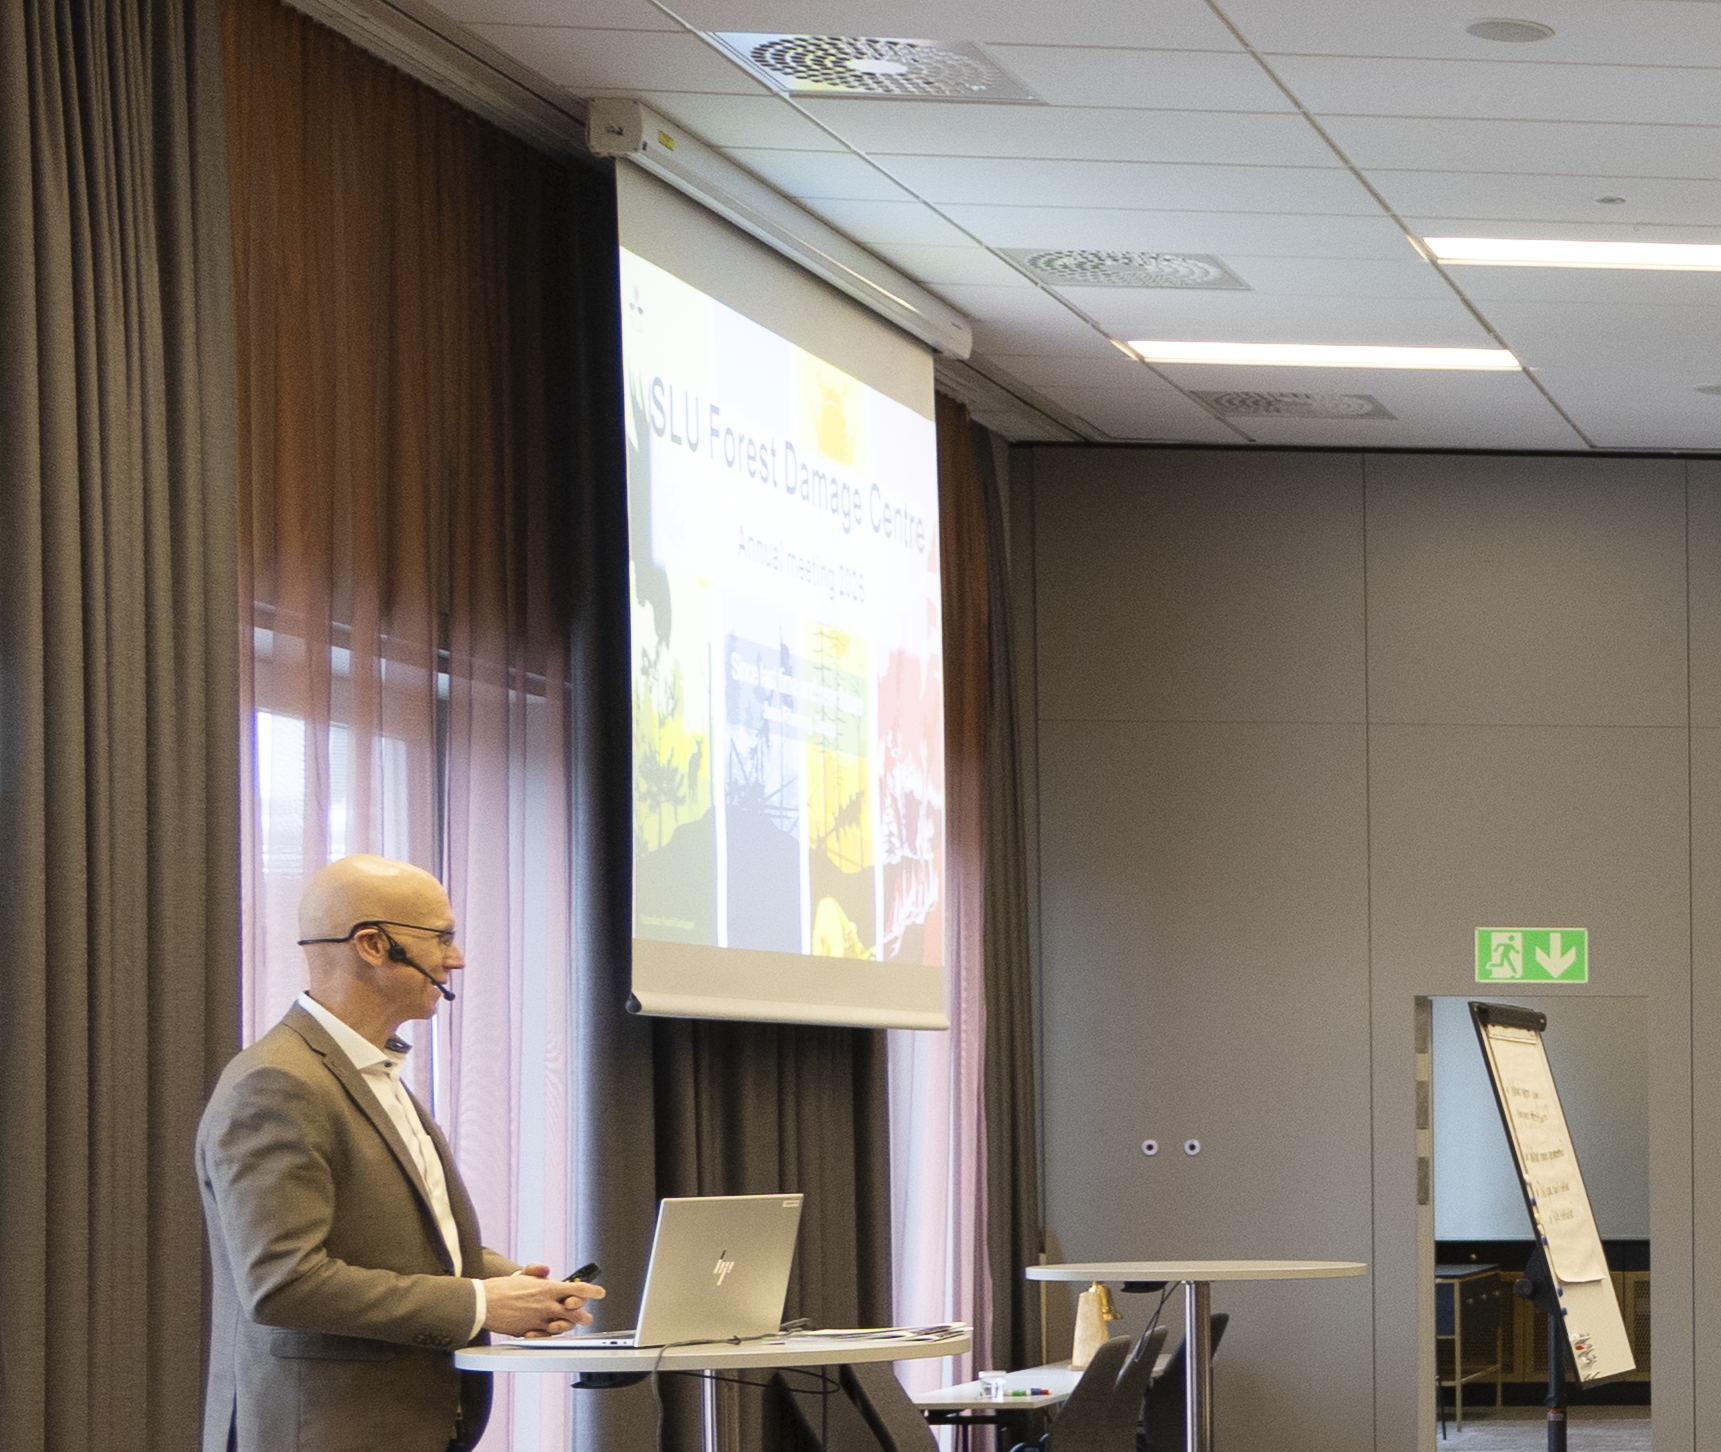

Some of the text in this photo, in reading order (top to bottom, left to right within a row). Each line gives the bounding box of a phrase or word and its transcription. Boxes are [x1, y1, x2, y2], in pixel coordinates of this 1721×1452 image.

[650, 376, 925, 554] SLU Forest Damage Centre
[738, 524, 865, 603] Annual meeting 2026
[731, 651, 759, 686] Since
